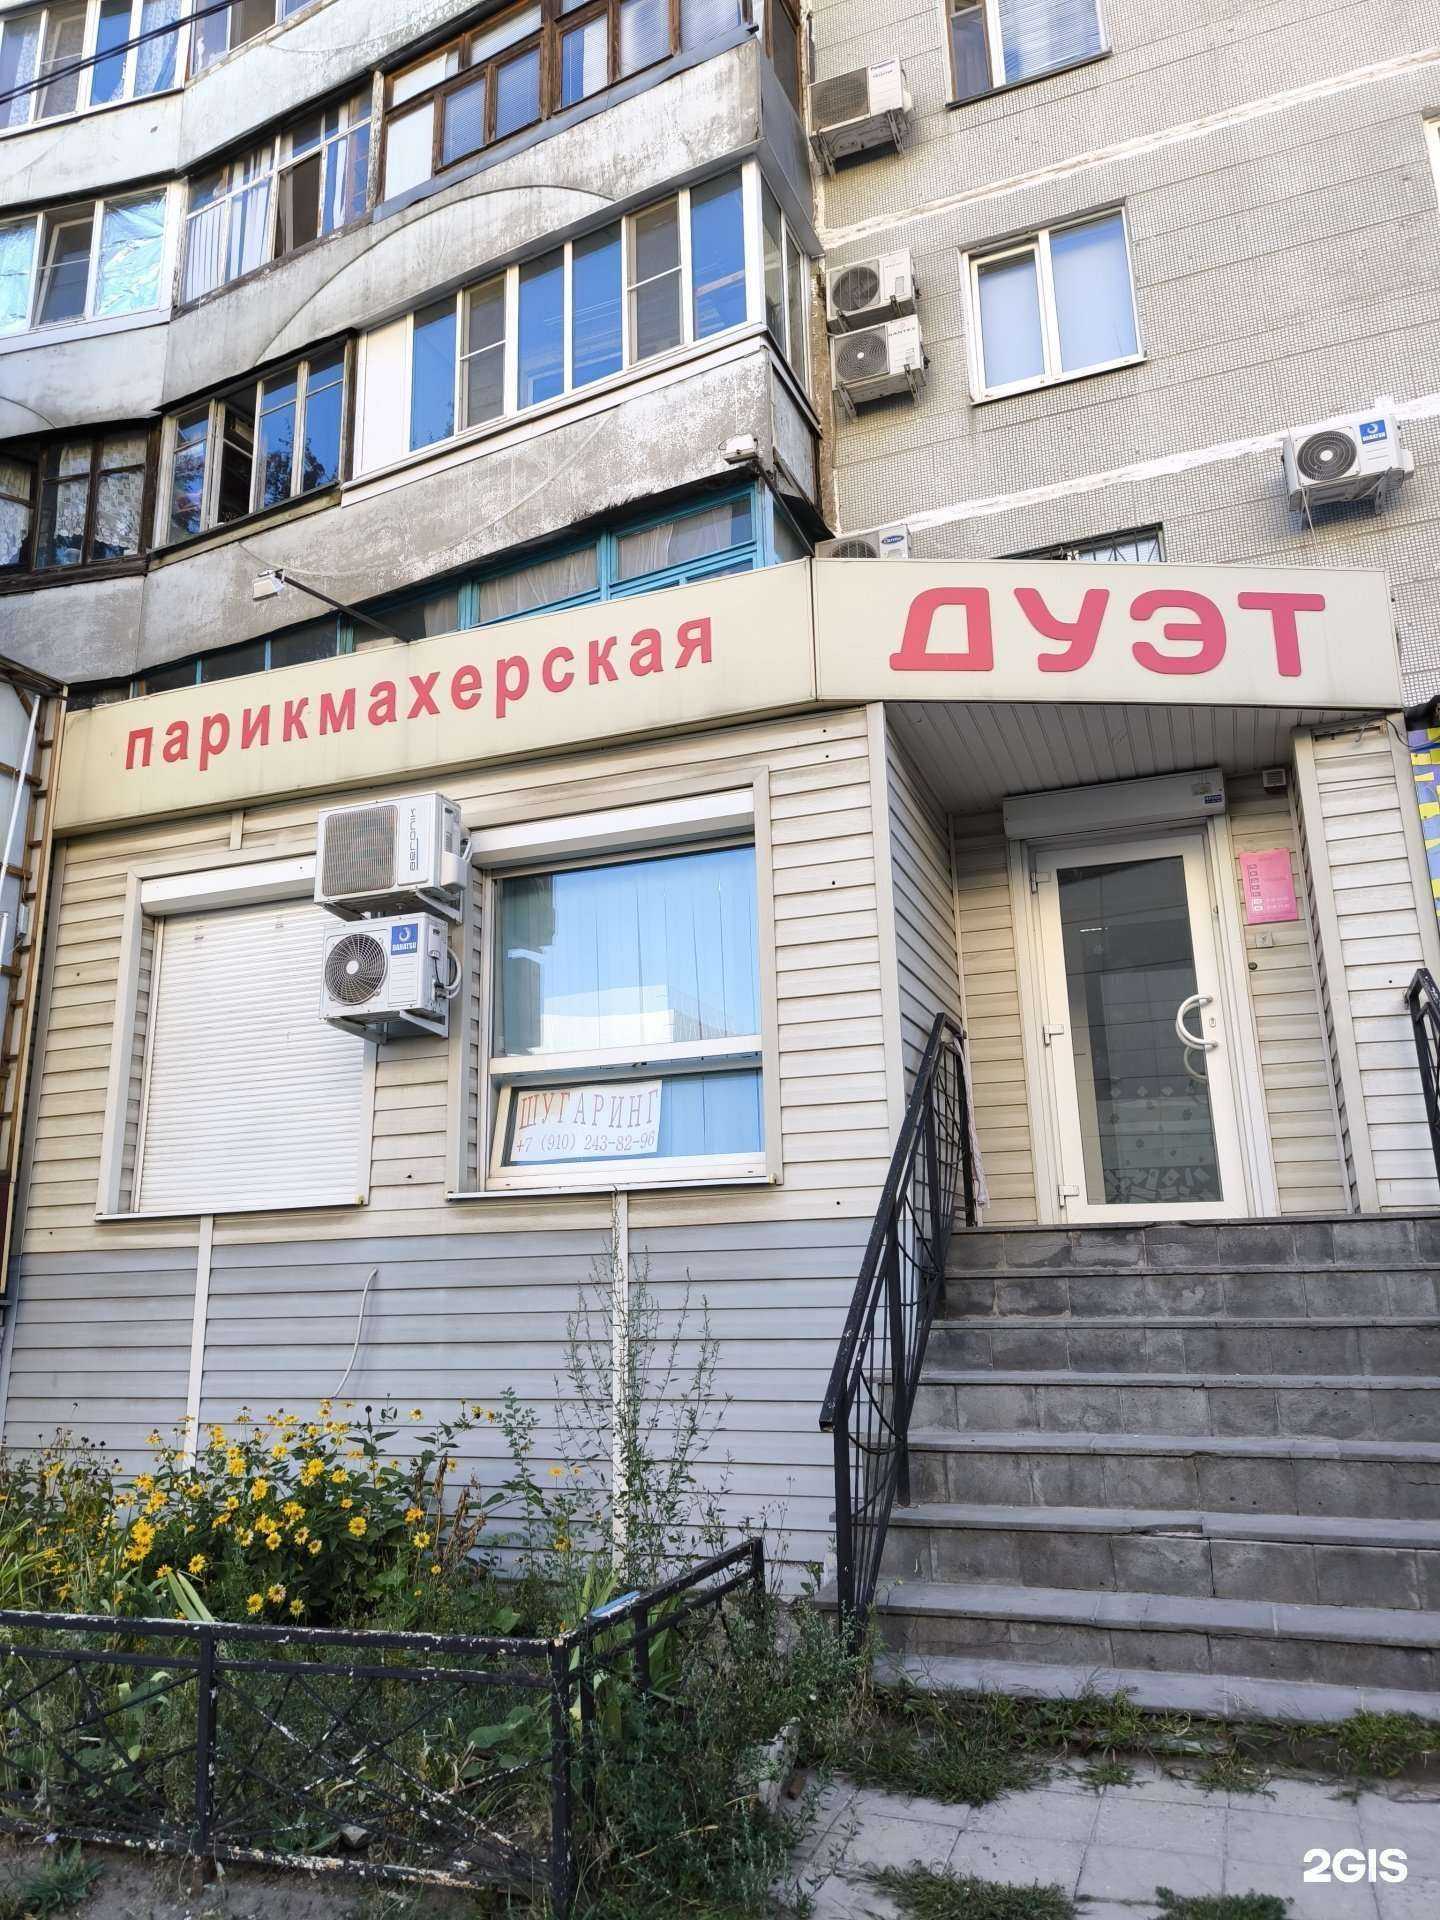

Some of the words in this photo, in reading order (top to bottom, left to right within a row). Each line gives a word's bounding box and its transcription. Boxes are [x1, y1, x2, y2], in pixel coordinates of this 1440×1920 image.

[889, 587, 1326, 677] ДУЭТ
[125, 616, 712, 771] парикмахерская
[408, 807, 418, 872] aeronik
[519, 1089, 659, 1130] ШУГАРИНГ
[516, 1136, 534, 1153] +7
[541, 1132, 576, 1152] (910)
